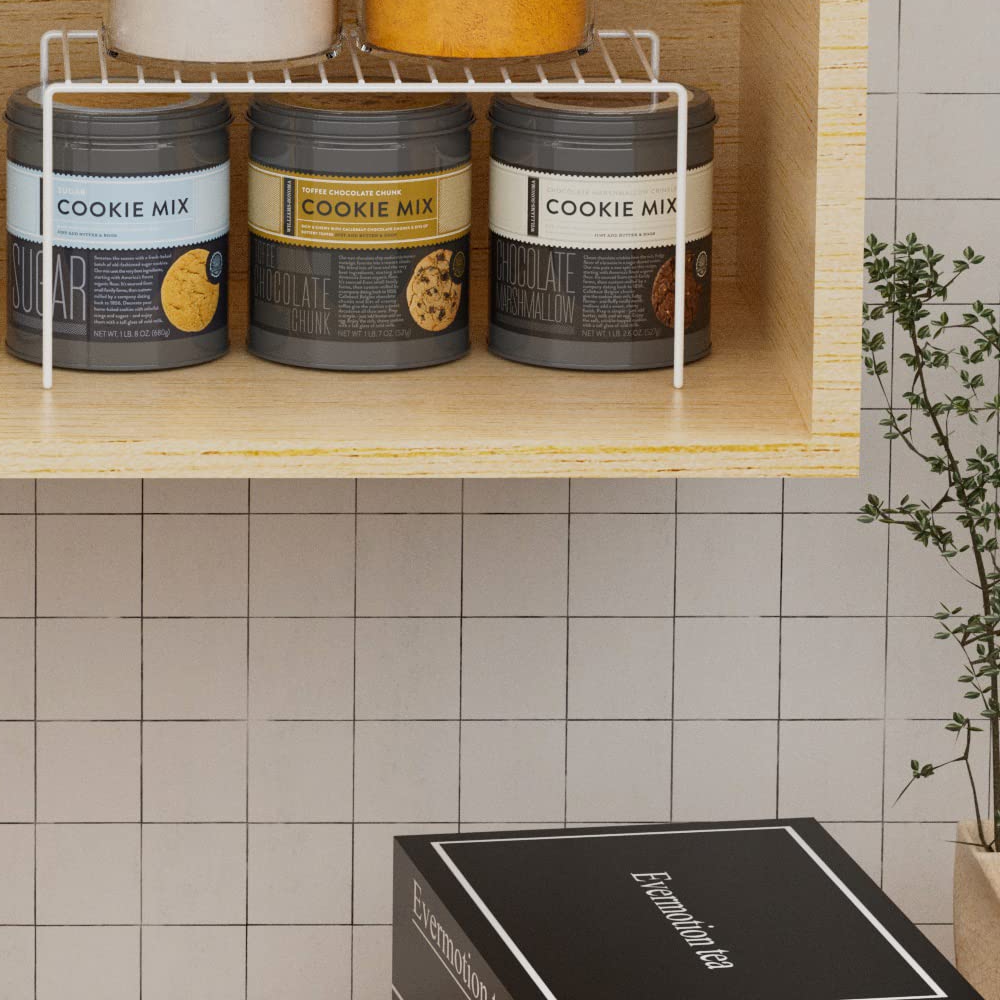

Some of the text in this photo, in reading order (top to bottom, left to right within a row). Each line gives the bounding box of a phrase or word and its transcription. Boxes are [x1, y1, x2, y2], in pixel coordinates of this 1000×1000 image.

[302, 187, 327, 195] TOFFEE
[329, 189, 374, 197] CHOCOLATE
[57, 197, 189, 218] COOKIE MIX
[302, 197, 433, 218] COOKIE MIX
[546, 197, 677, 217] COOKIE MIX
[497, 238, 576, 294] CHOCOLATE
[255, 264, 331, 310] CHOCOLATE
[292, 307, 331, 336] CHUNK
[630, 871, 734, 969] Evermotion tea
[413, 879, 487, 1000] Evermotion
